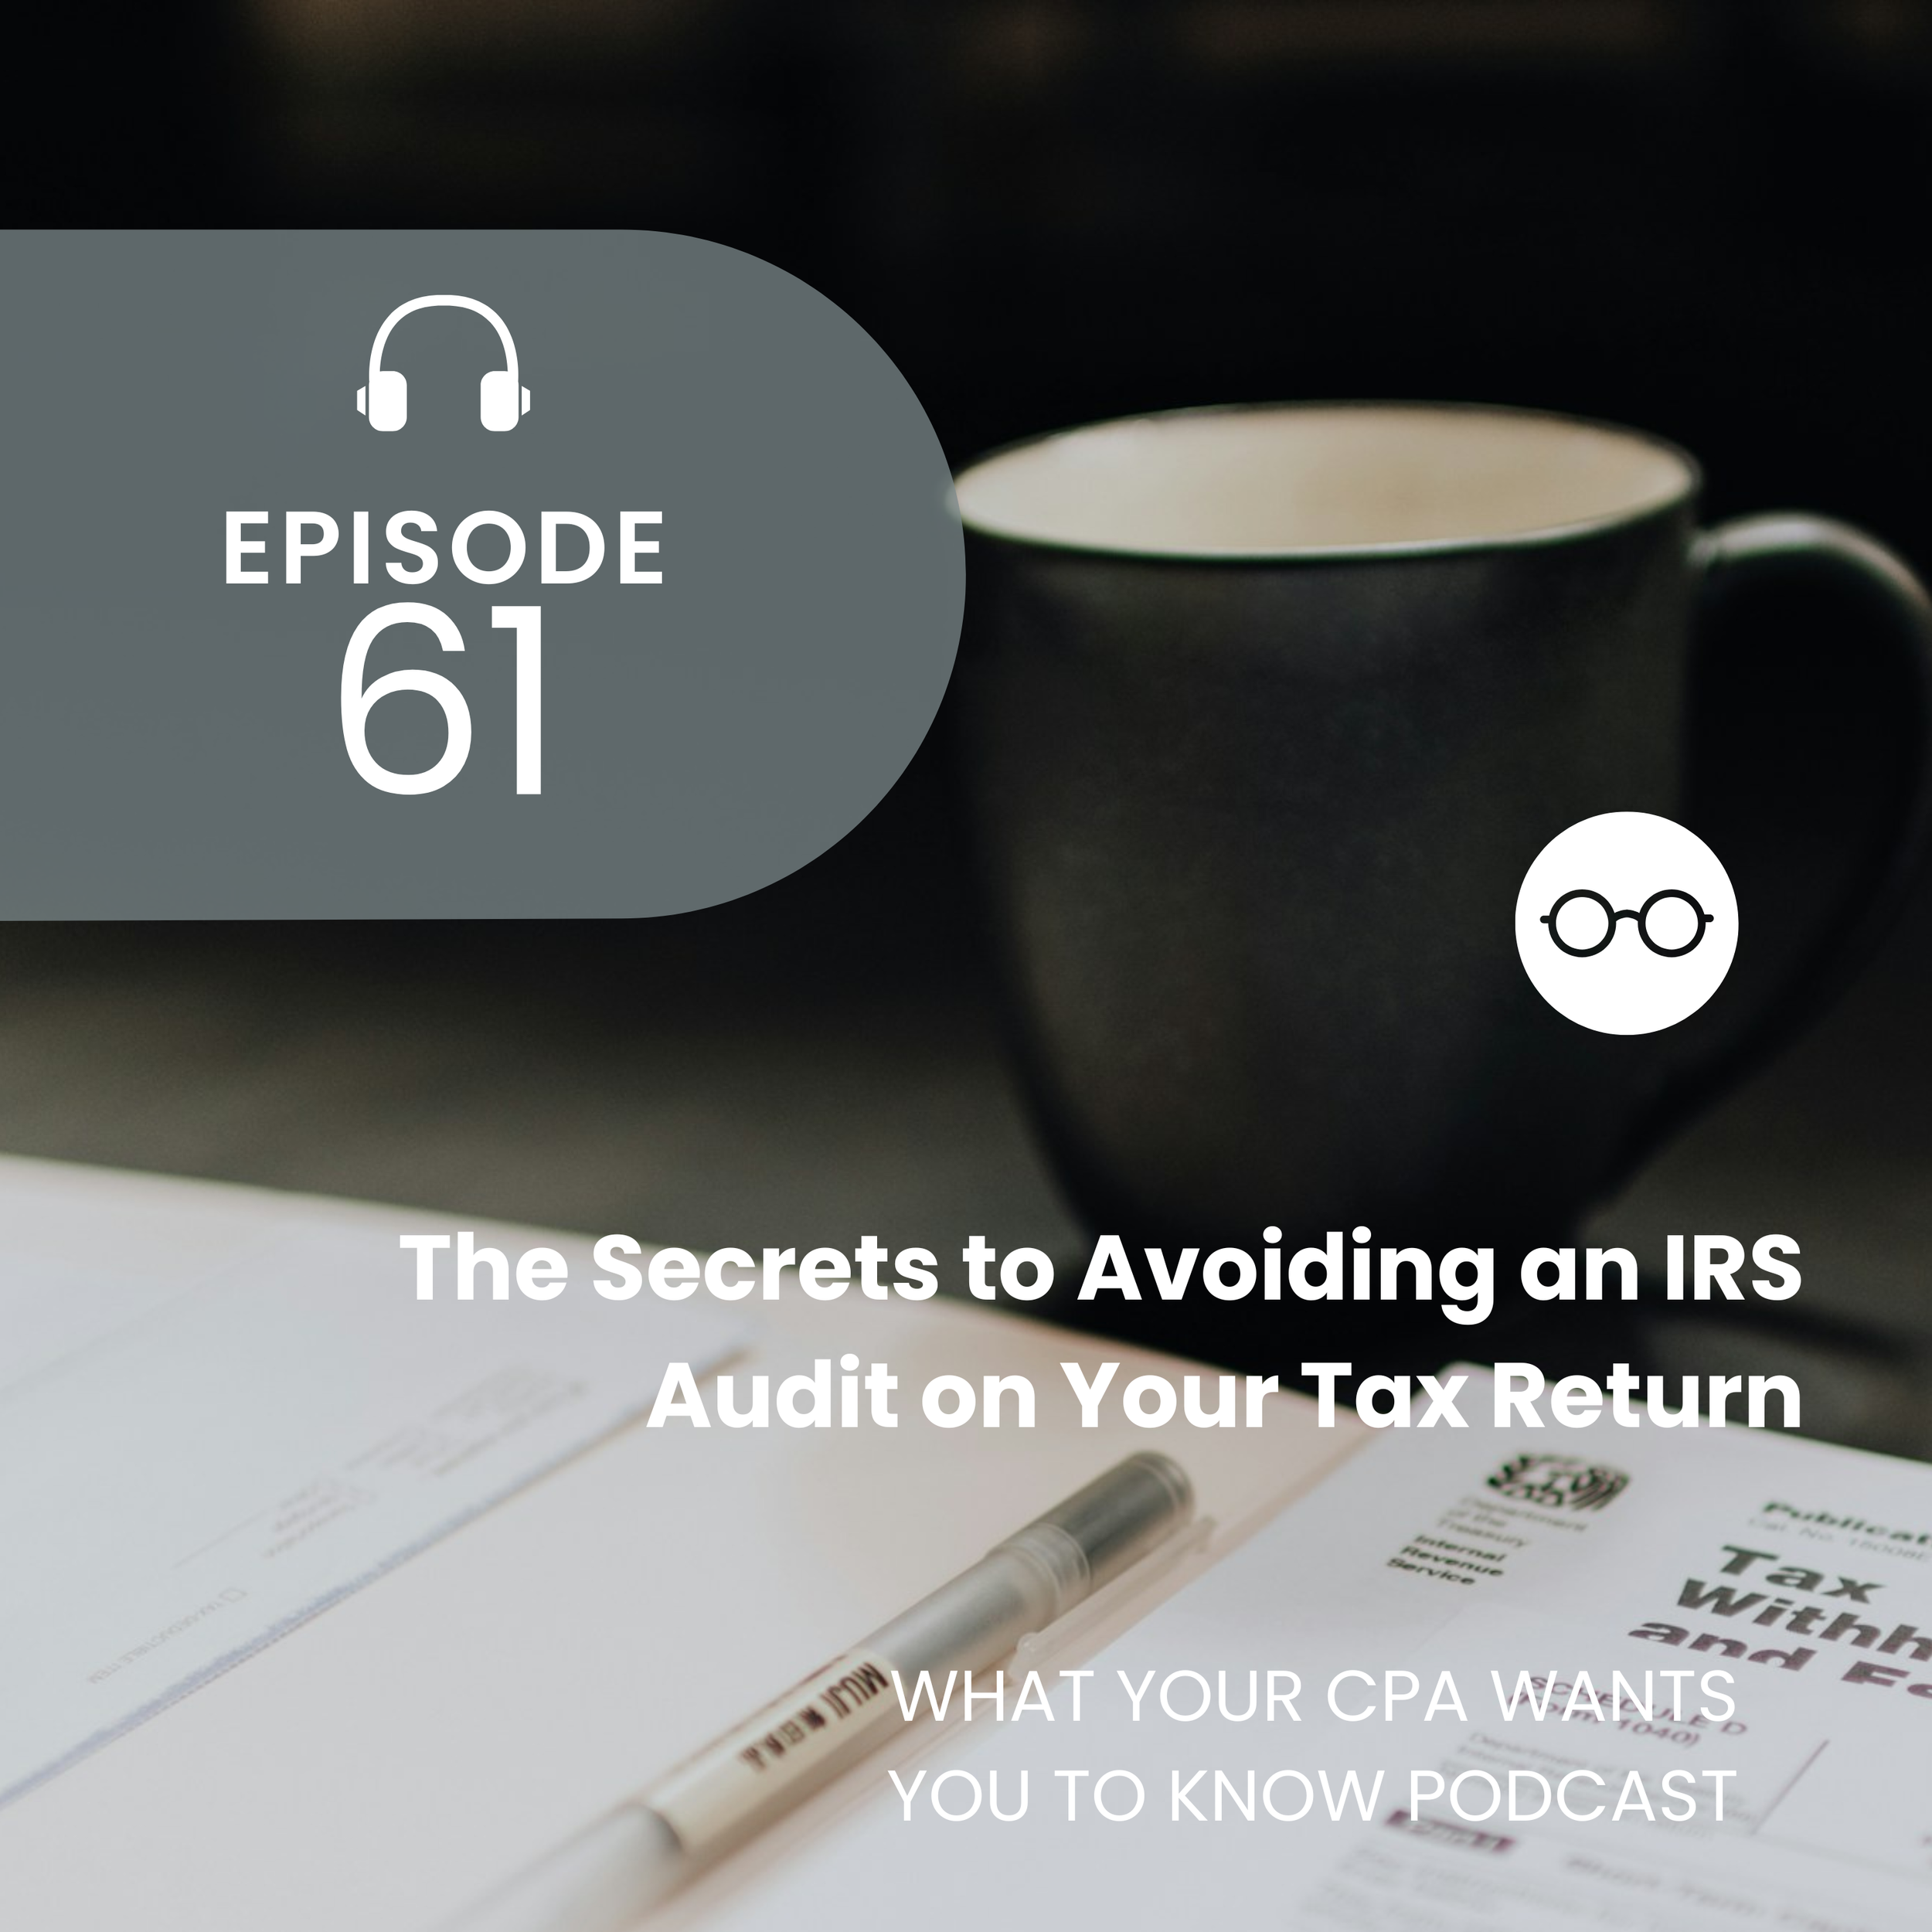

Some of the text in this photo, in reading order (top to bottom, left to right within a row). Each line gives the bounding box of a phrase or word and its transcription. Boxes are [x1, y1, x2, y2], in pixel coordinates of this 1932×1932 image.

[1413, 1535, 1508, 1562] Internal
[1436, 1519, 1528, 1548] Treasury
[1386, 1557, 1475, 1585] Service
[1400, 1546, 1505, 1577] Revenue
[1719, 1545, 1887, 1604] Tax
[1628, 1621, 1818, 1672] and
[820, 1662, 889, 1719] MUJI
